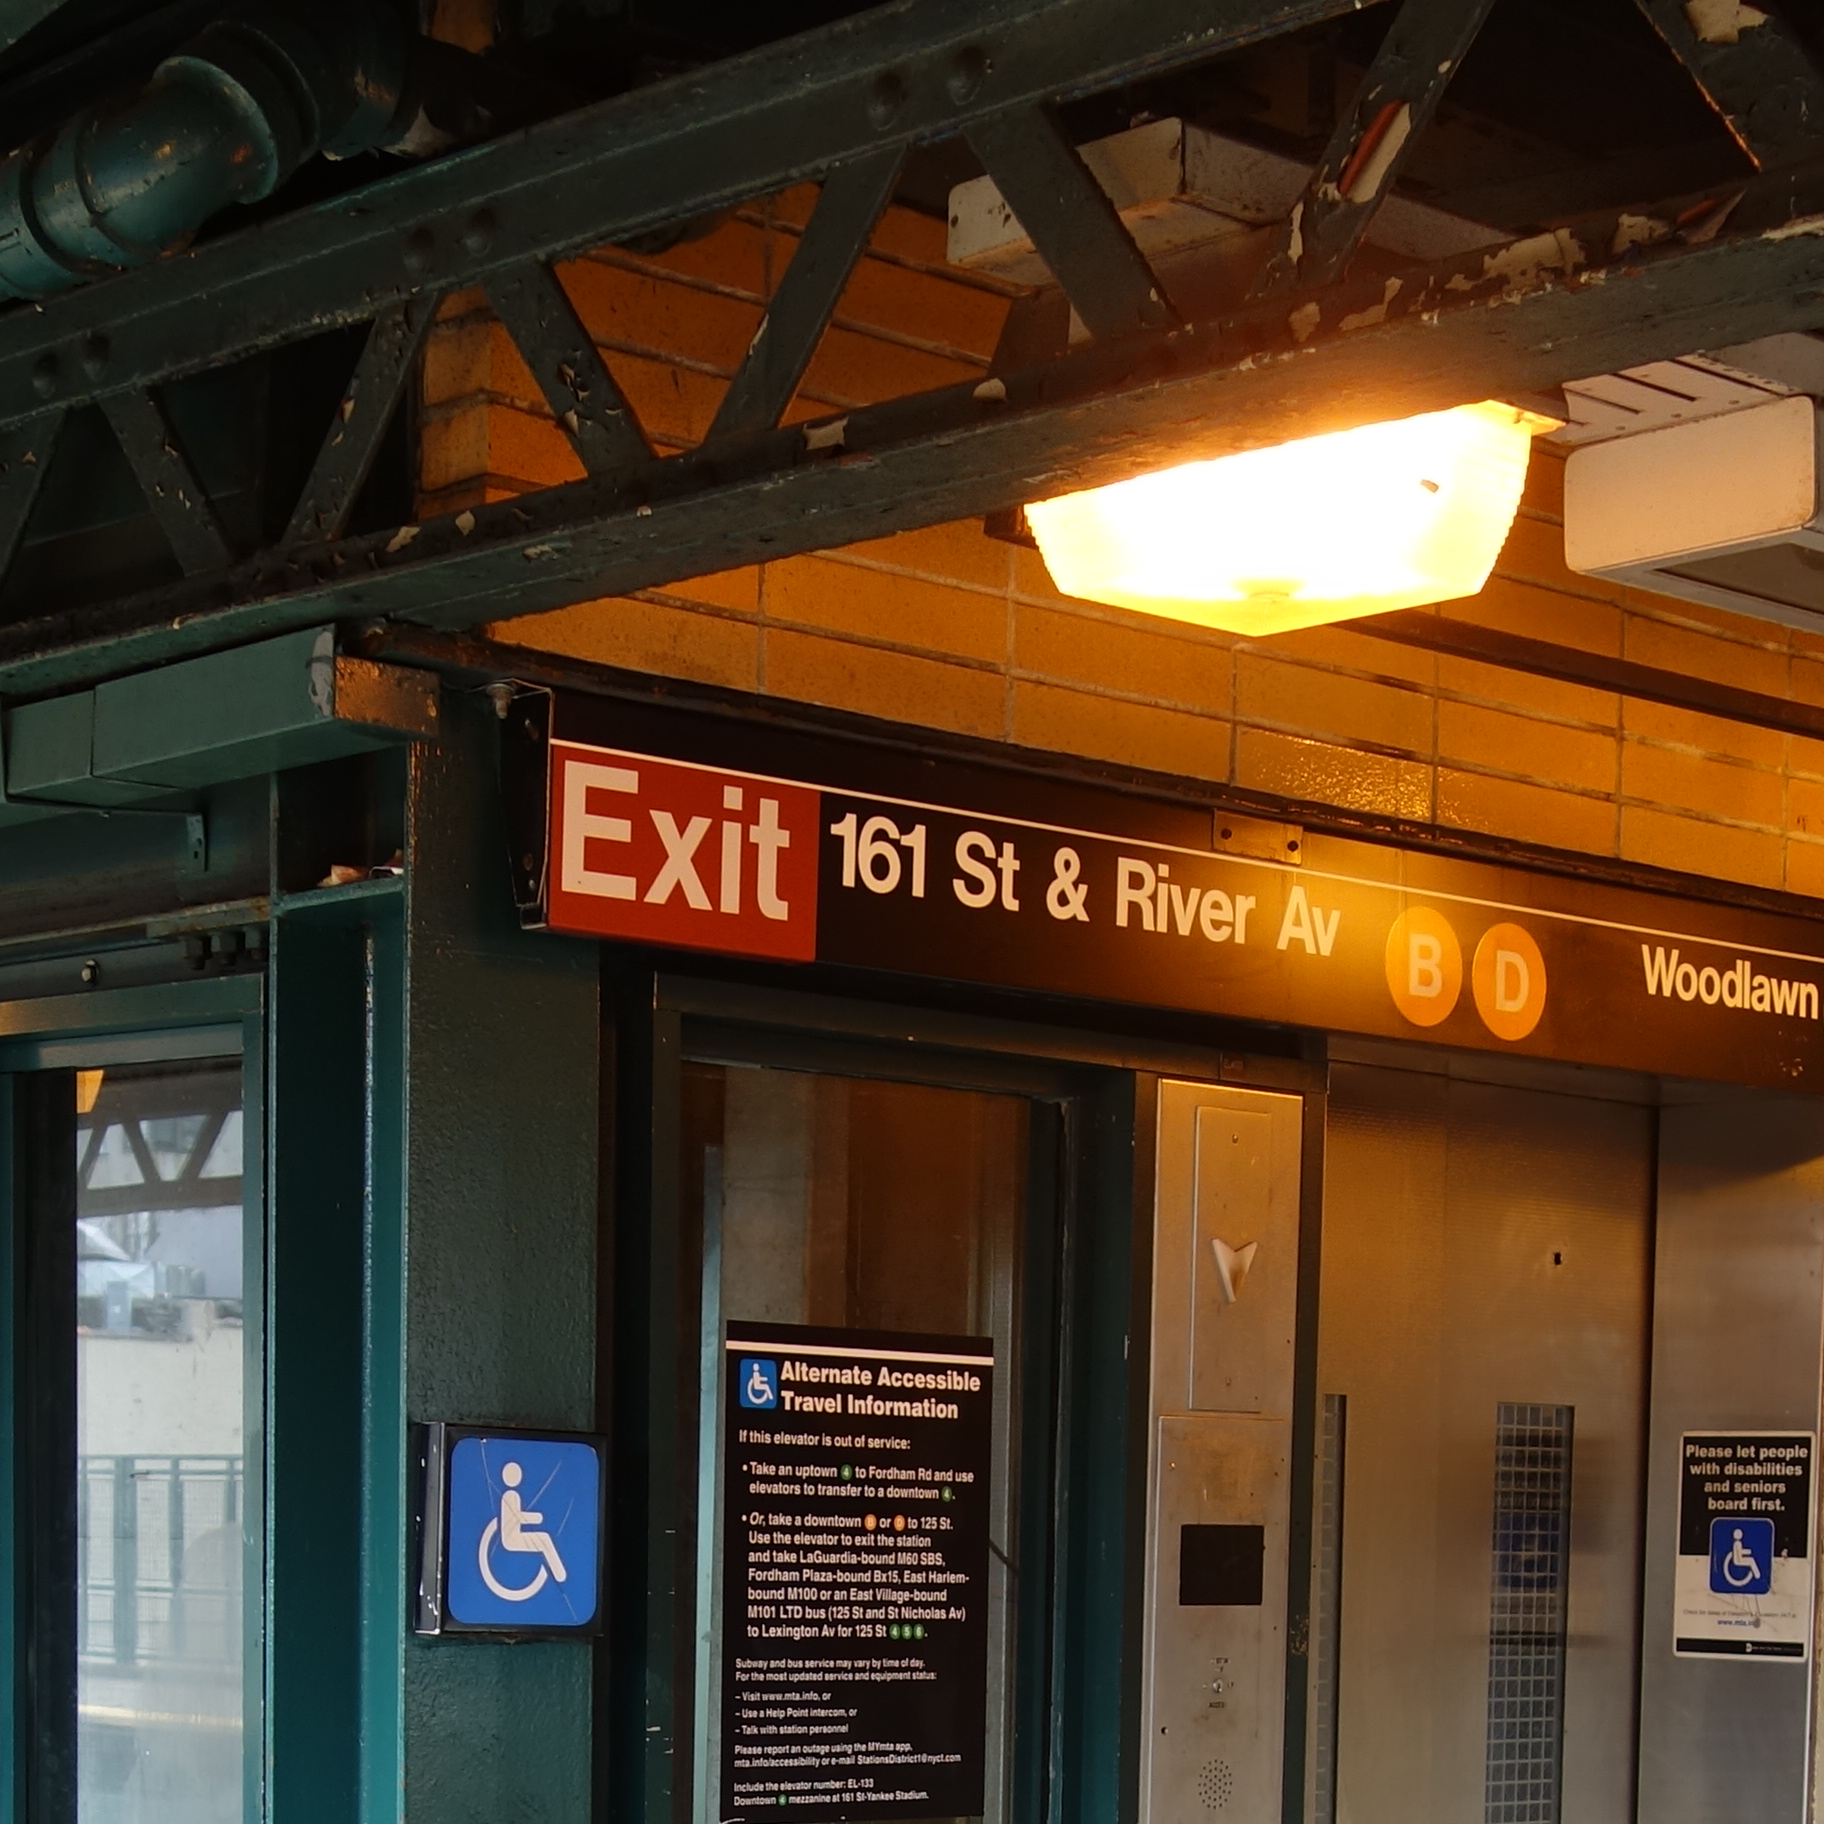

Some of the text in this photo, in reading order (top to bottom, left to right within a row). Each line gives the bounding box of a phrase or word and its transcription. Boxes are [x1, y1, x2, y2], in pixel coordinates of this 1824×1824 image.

[561, 760, 790, 921] Exit
[830, 813, 1529, 1013] 161 St & River Av B D
[1642, 943, 1818, 1020] Woodlawn
[781, 1361, 981, 1391] Alternate Accessible
[781, 1390, 958, 1419] Travel Information
[739, 1429, 910, 1449] If this elevator is out of service:
[1686, 1444, 1808, 1461] Please let people
[749, 1461, 776, 1476] Take
[778, 1465, 793, 1476] an
[795, 1464, 838, 1479] uptown
[855, 1466, 867, 1479] to
[869, 1466, 916, 1480] Fordham
[918, 1468, 932, 1481] Rd
[933, 1469, 953, 1482] and
[955, 1472, 974, 1483] use
[1690, 1462, 1803, 1476] with disabilities
[749, 1481, 801, 1495] elevators
[803, 1483, 815, 1495] to
[817, 1483, 862, 1497] transfer
[864, 1485, 876, 1497] to
[877, 1487, 884, 1497] a
[886, 1485, 939, 1499] downtown
[1704, 1480, 1786, 1493] and seniors
[1708, 1497, 1785, 1511] board first.
[750, 1512, 766, 1526] Or,
[768, 1513, 792, 1526] take
[794, 1516, 802, 1526] a
[804, 1513, 862, 1527] downtown
[879, 1518, 892, 1528] or
[907, 1517, 918, 1529] to
[920, 1517, 937, 1530] 125
[939, 1517, 953, 1530] St.
[749, 1531, 931, 1547] Use the elevator to exit the station
[748, 1550, 945, 1566] and take LaGuardia-bound M60 SBS,
[748, 1568, 800, 1581] Fordham
[802, 1569, 871, 1582] Plaza-bound
[873, 1570, 901, 1584] Bx15,
[903, 1570, 926, 1583] East
[748, 1587, 947, 1603] bound M100 or an East Village-bound
[748, 1605, 966, 1622] M101 LTD bus (125 St and St Nicholas Av)
[747, 1625, 759, 1637] to
[762, 1624, 819, 1640] Lexington
[821, 1624, 835, 1637] Av
[837, 1624, 853, 1637] for
[855, 1624, 873, 1637] 125
[875, 1624, 887, 1637] St
